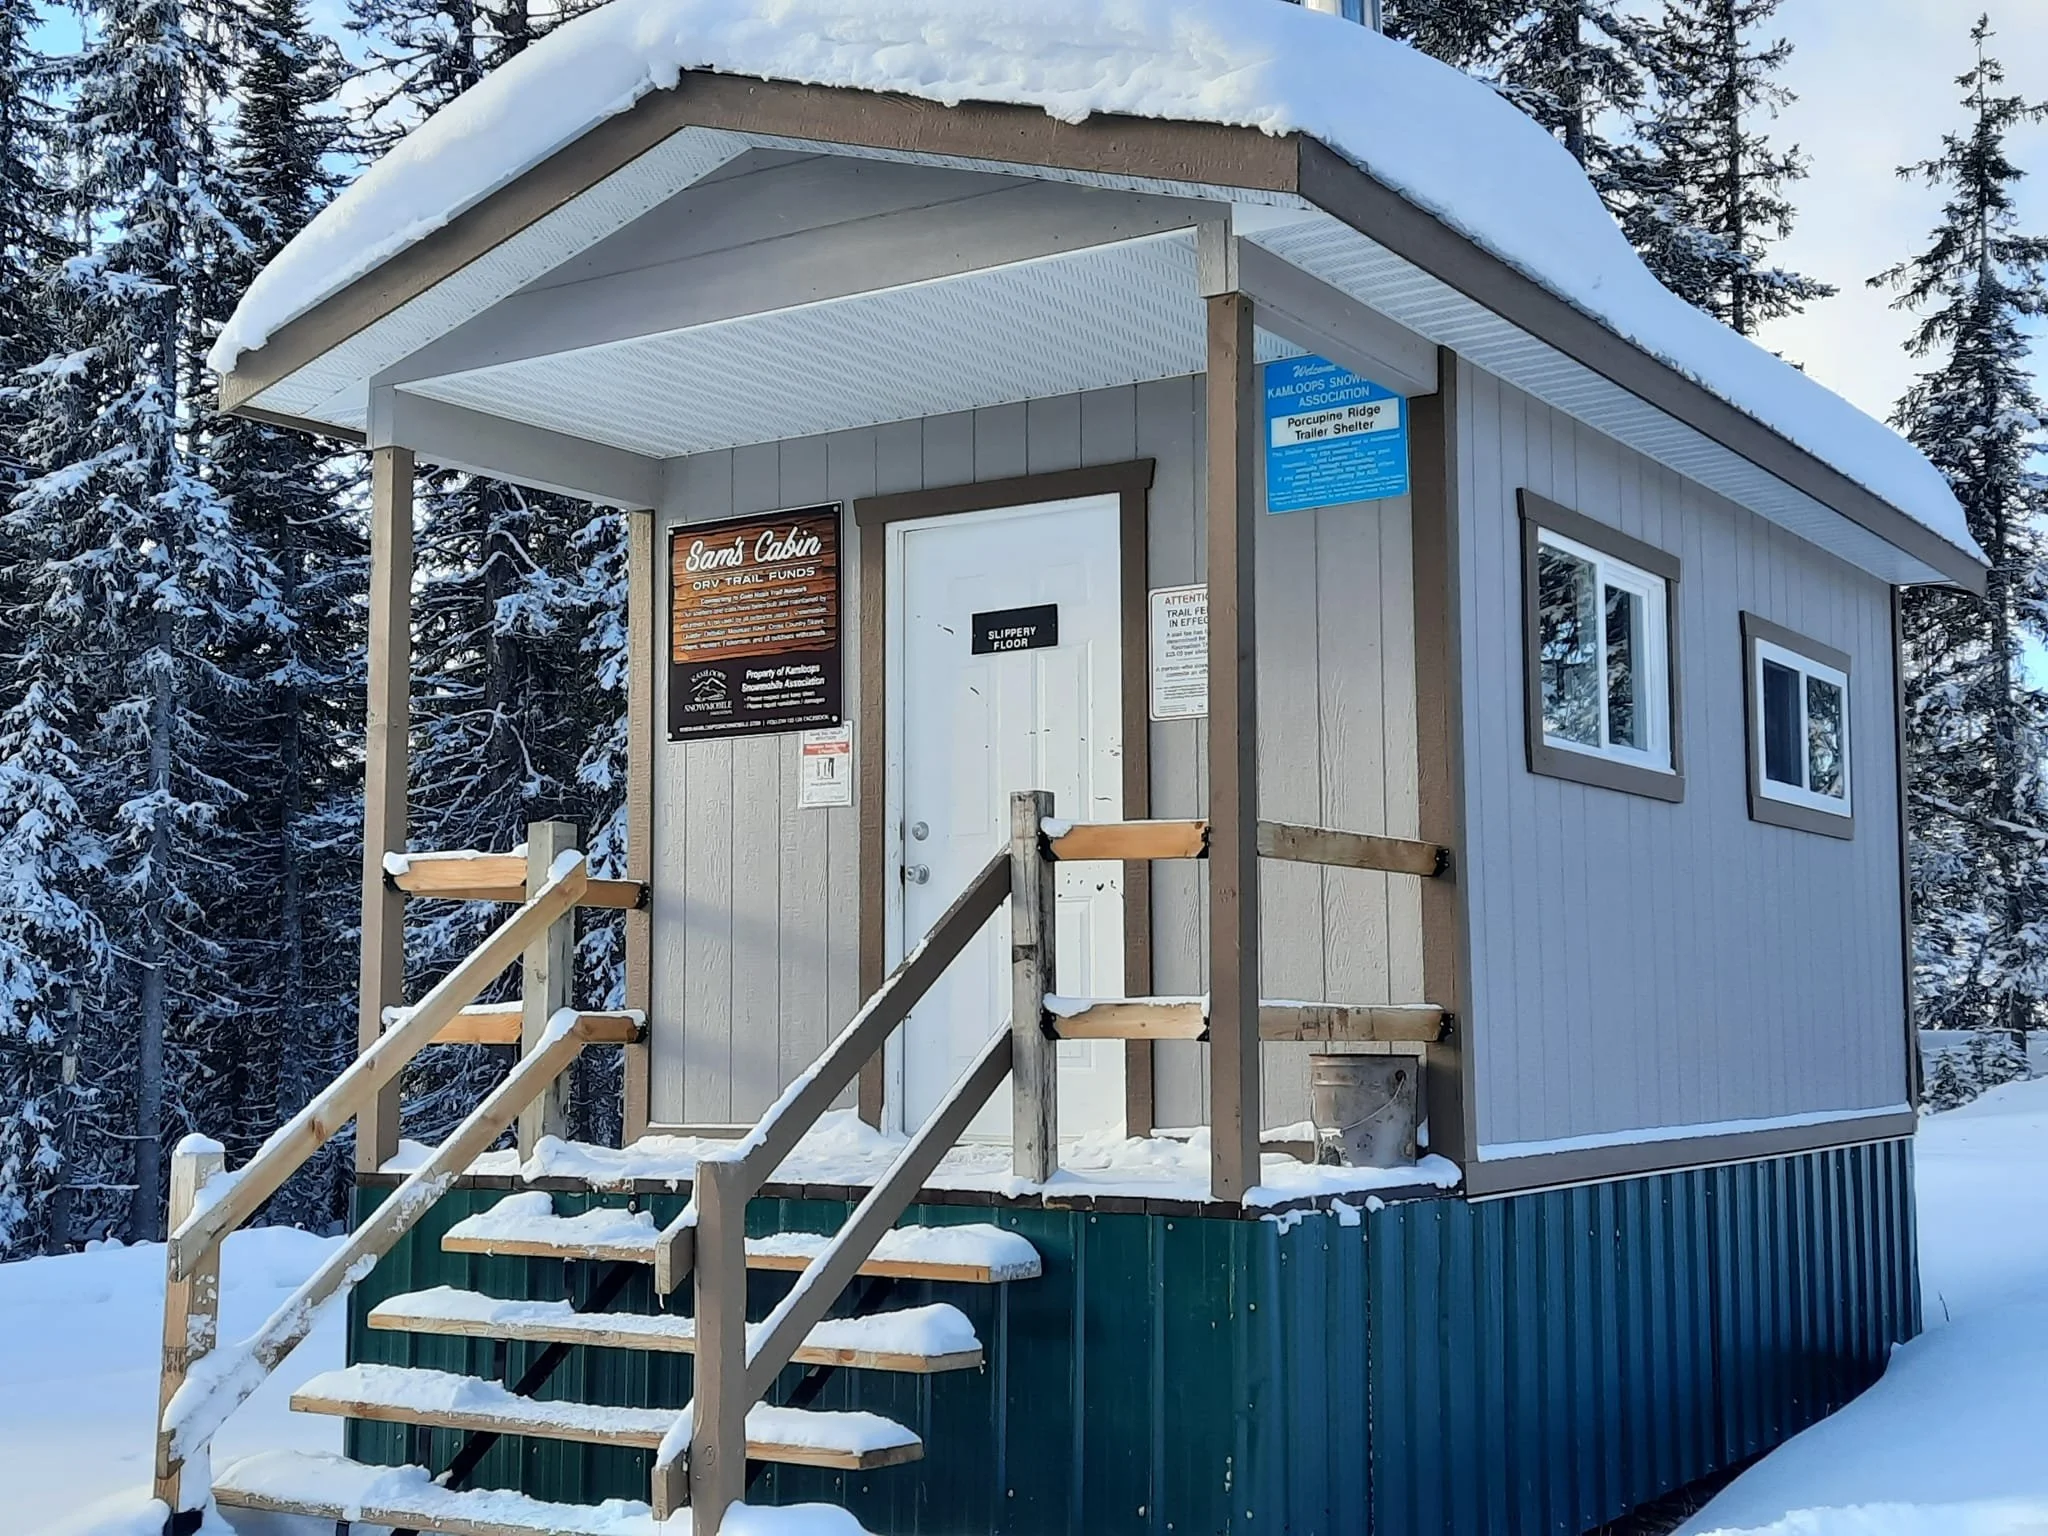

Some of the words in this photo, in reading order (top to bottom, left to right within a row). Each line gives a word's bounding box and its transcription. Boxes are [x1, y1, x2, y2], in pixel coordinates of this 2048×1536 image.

[1267, 379, 1325, 399] KAMLOOPS
[1329, 374, 1367, 388] SNOW
[1299, 386, 1370, 408] ASSOCIATION
[1287, 411, 1343, 428] Porcupine
[1347, 404, 1381, 419] Ridge
[1295, 427, 1329, 441] Trailer
[1333, 420, 1375, 435] Shelter
[686, 536, 744, 572] Sam's
[754, 526, 822, 563] Cabin
[693, 579, 720, 590] ORV
[726, 574, 764, 586] TRAIL
[768, 566, 816, 580] FUNDS
[1167, 608, 1192, 618] TRAIL
[1194, 606, 1208, 616] FE
[1169, 619, 1178, 628] IN
[988, 626, 1037, 640] SLIPPERY
[993, 638, 1028, 651] FLOOR
[746, 669, 776, 680] Property
[777, 666, 785, 676] of
[784, 677, 825, 688] Association
[684, 701, 732, 712] SNOWMOBILE
